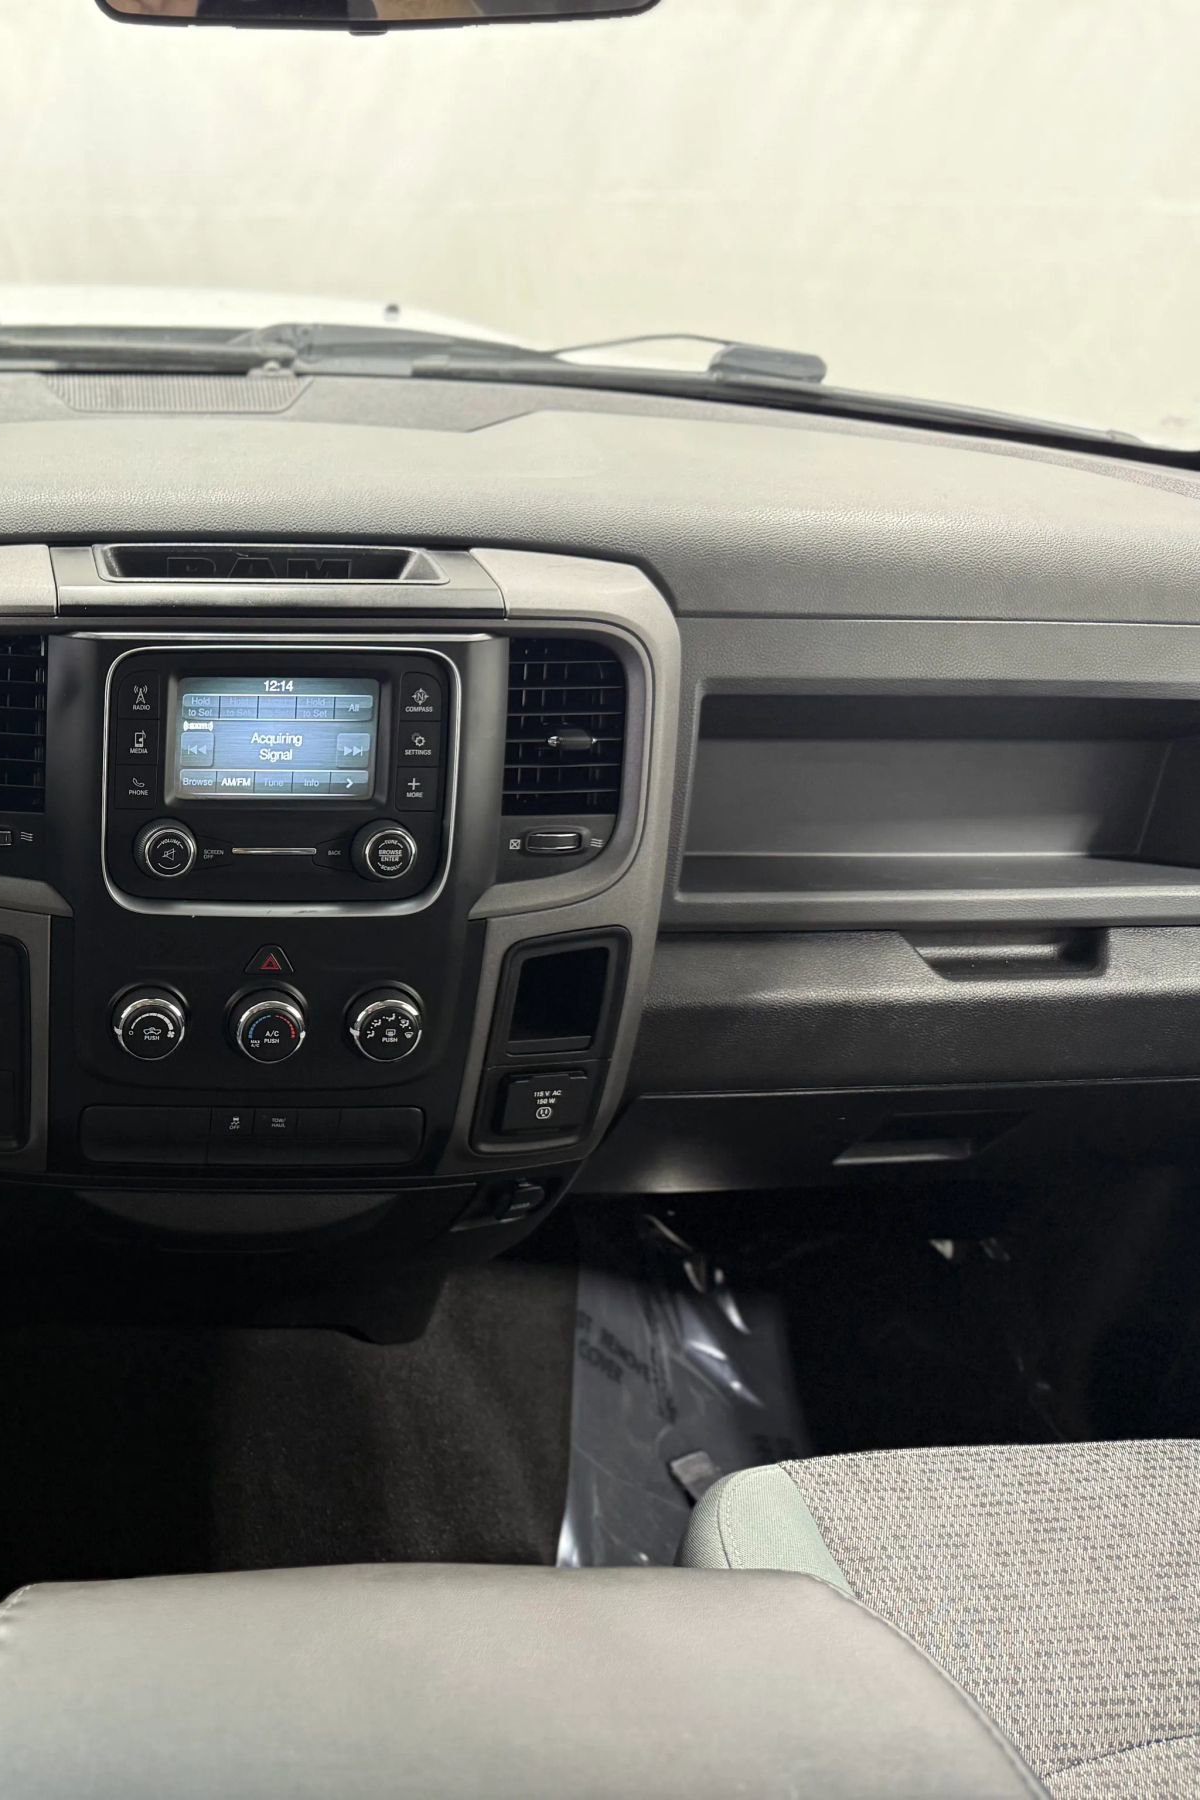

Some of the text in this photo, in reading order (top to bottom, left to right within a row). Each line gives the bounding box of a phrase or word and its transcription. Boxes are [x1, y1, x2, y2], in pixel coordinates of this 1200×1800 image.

[263, 680, 294, 692] 12:14
[191, 697, 211, 706] Hold
[306, 698, 326, 707] Hold
[188, 709, 212, 717] to Set
[313, 709, 328, 718] Set
[250, 732, 303, 747] Acquiring
[259, 748, 293, 763] Signal
[183, 777, 213, 786] Browse
[221, 777, 251, 787] AM/FM
[303, 778, 320, 787] Info
[265, 1030, 280, 1038] A/C
